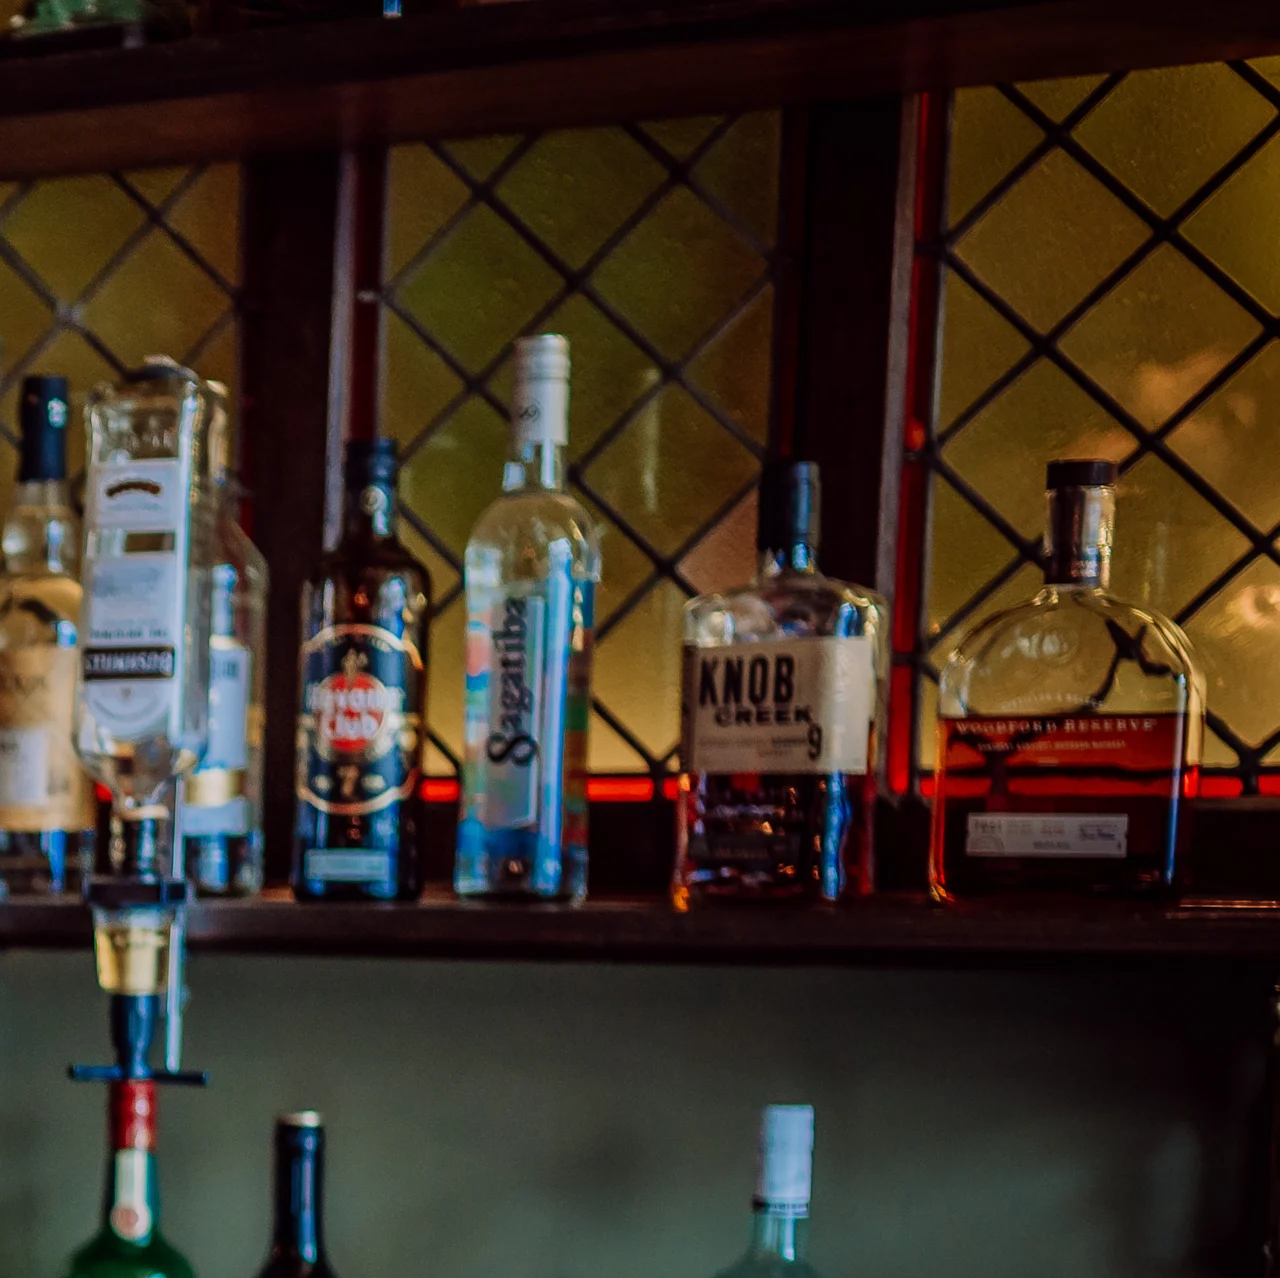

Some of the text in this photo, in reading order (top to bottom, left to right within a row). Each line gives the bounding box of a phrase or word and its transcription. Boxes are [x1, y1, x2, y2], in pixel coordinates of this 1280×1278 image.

[487, 598, 538, 767] Sagatiba
[698, 654, 795, 706] KNOB
[320, 713, 380, 739] Club
[714, 704, 813, 728] CREEK
[955, 716, 1153, 736] WOODFORD RESERVE
